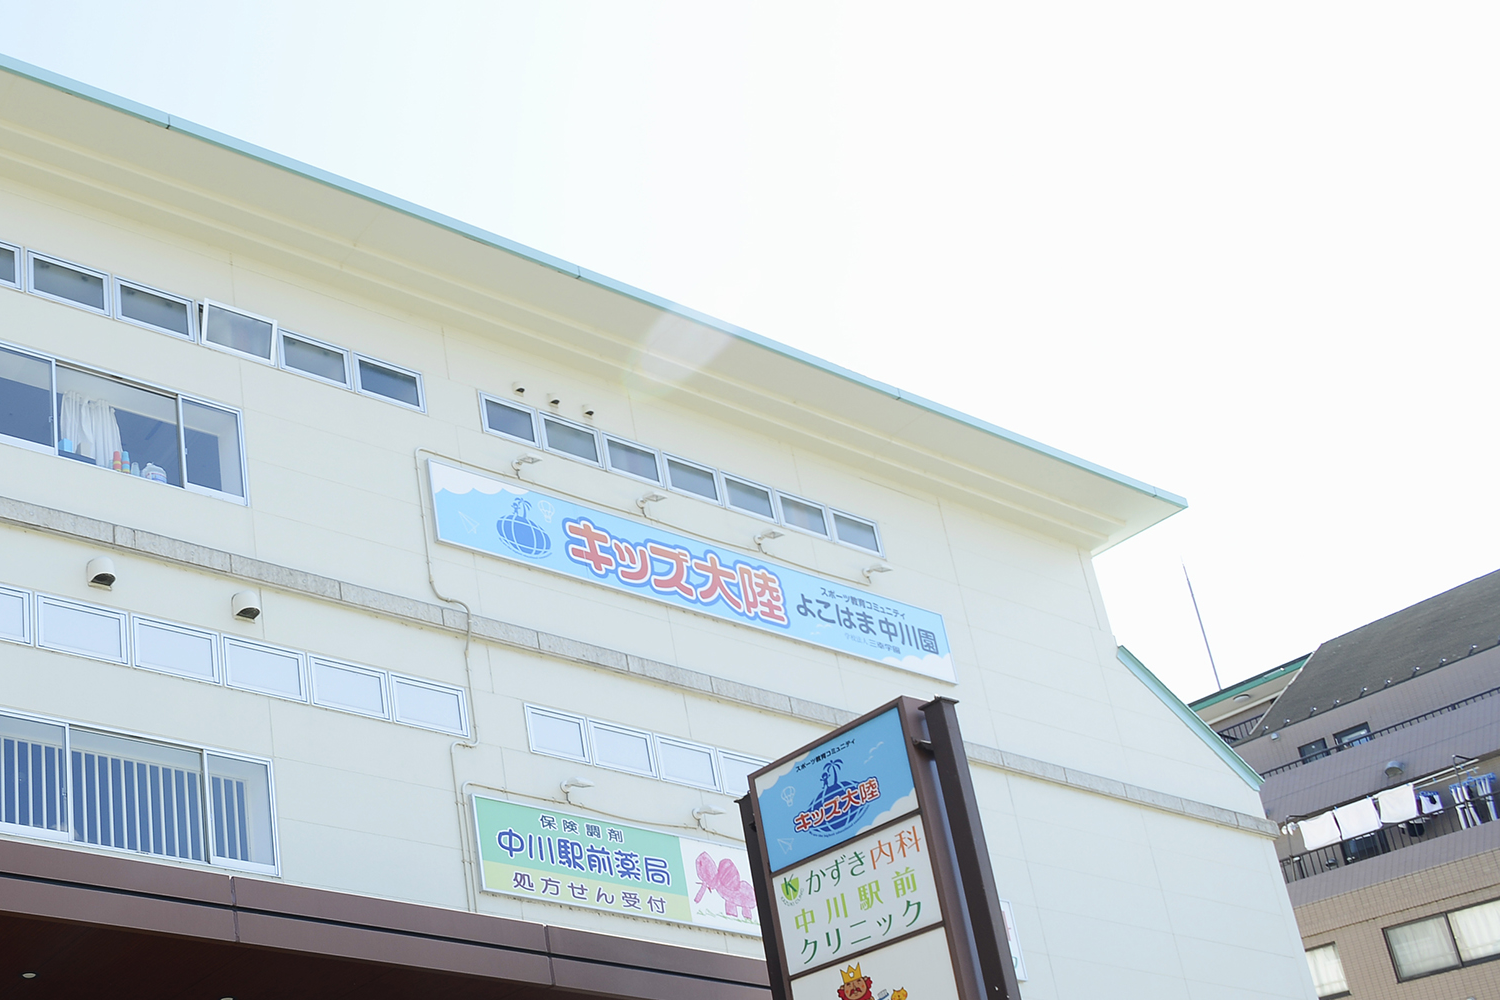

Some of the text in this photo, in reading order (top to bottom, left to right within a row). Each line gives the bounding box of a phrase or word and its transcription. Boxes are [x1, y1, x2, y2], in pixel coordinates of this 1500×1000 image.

[564, 519, 788, 626] キッズ大陸
[820, 587, 906, 620] スポーツ教育コミュニティ
[796, 738, 856, 772] スポーツ教育コミュニティ
[539, 814, 625, 844] 保険調剤
[794, 777, 881, 832] キッズ大陸
[496, 828, 672, 887] 中川駅前薬局
[805, 825, 921, 895] かずき内科
[512, 872, 667, 914] 処方せん受付
[794, 866, 918, 934] 中川駅前
[800, 899, 922, 965] クリニック
